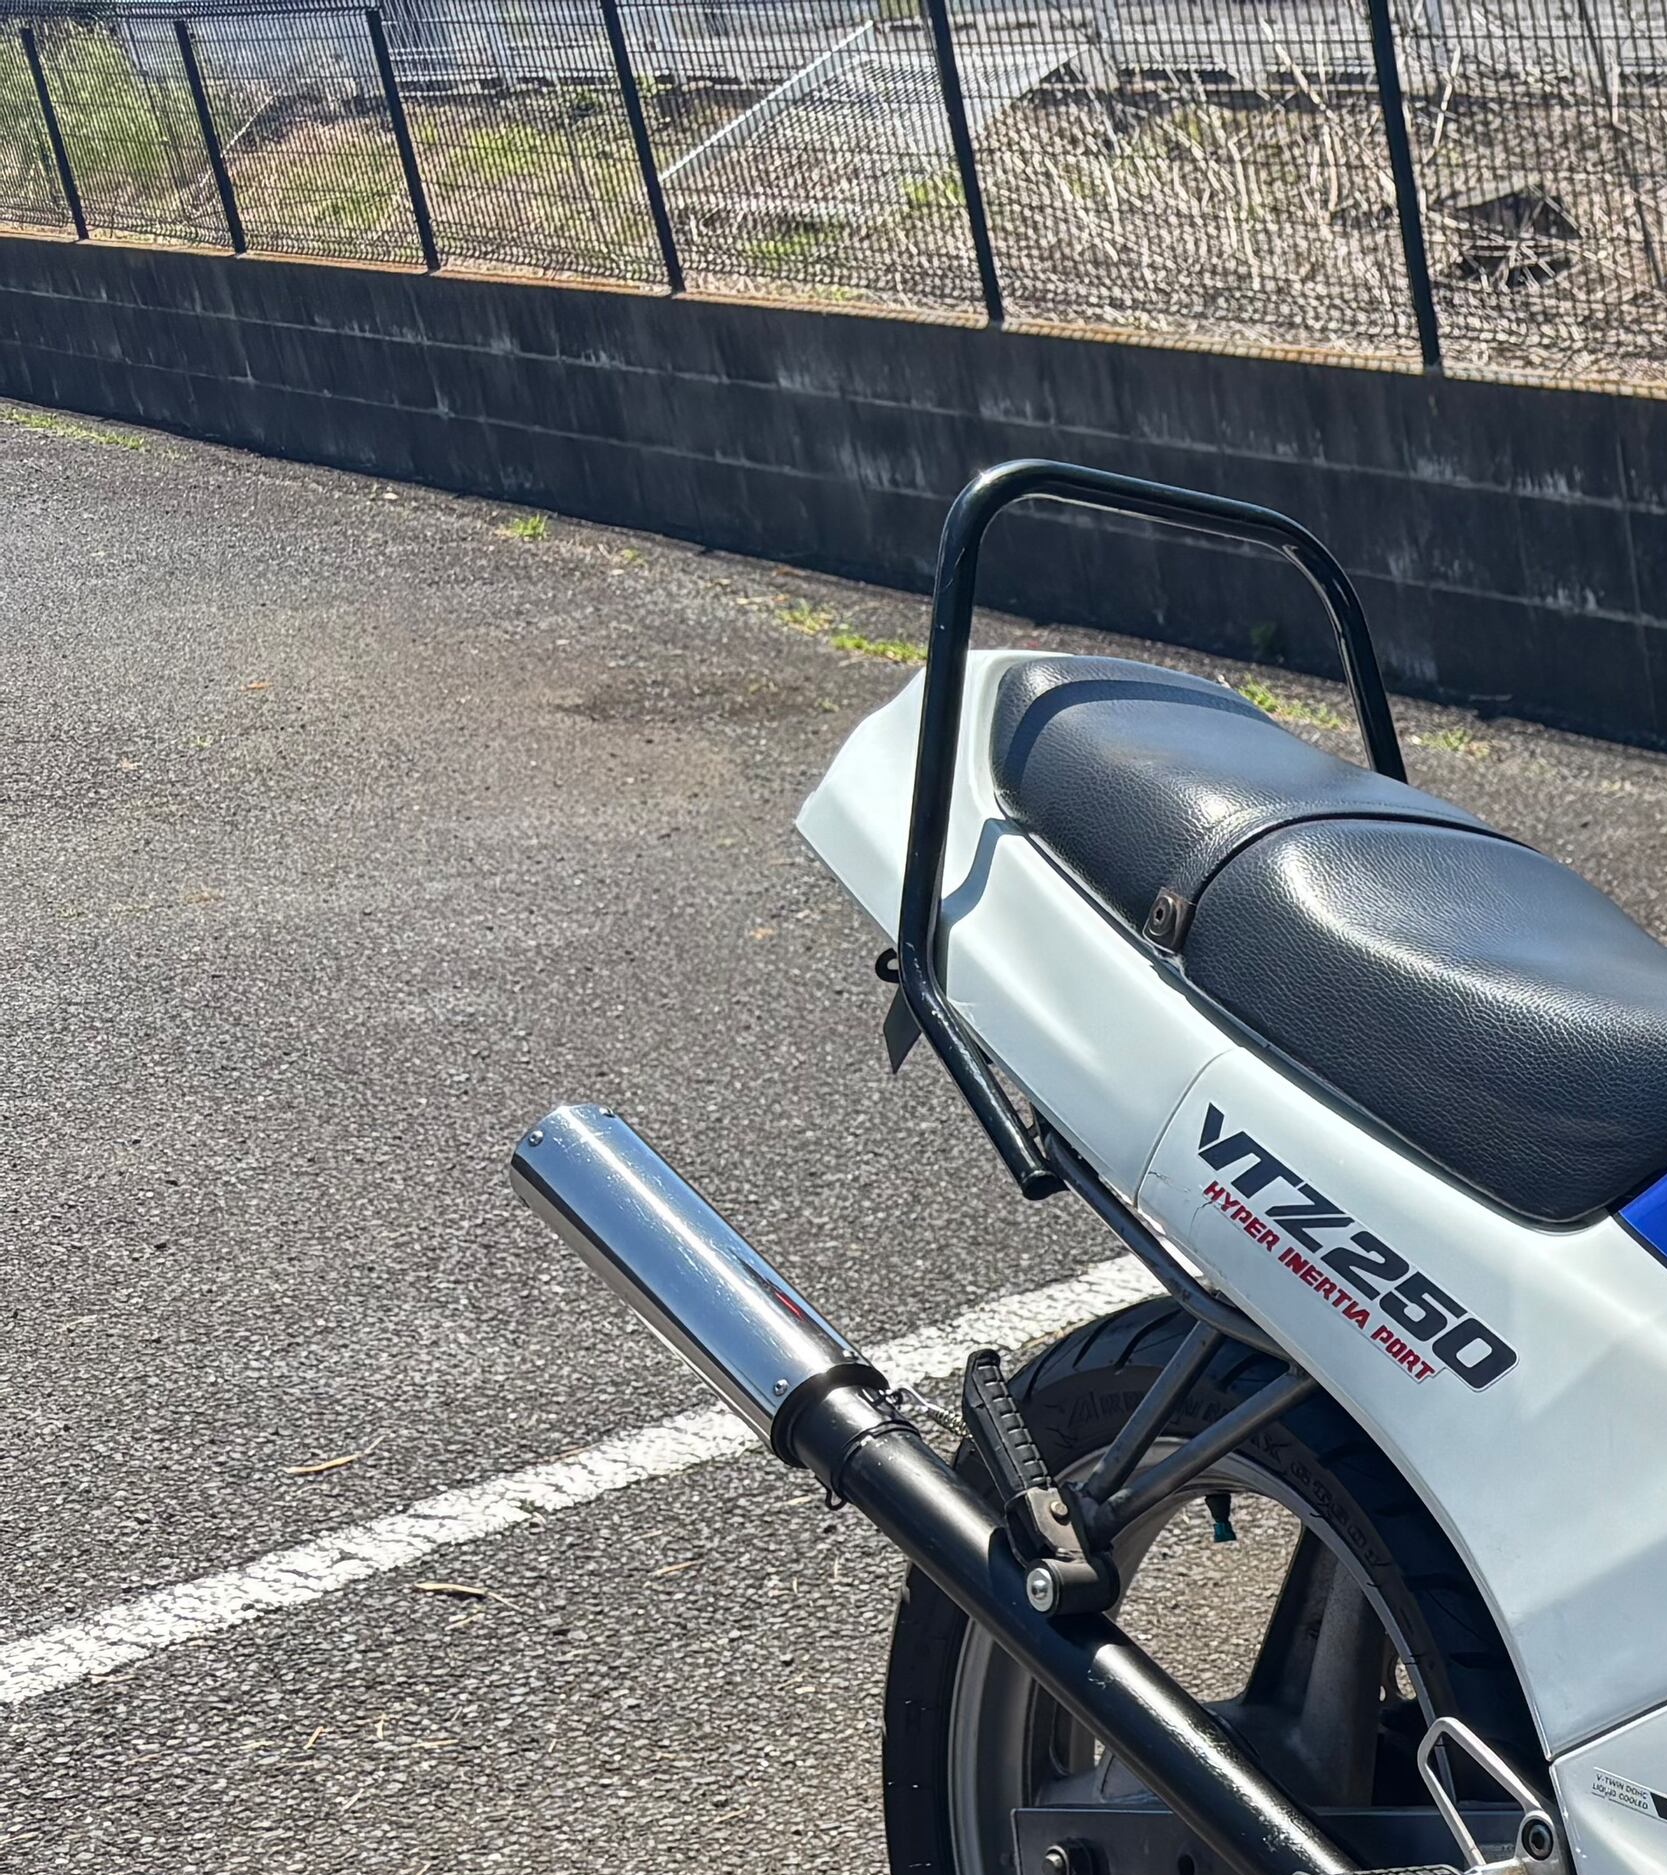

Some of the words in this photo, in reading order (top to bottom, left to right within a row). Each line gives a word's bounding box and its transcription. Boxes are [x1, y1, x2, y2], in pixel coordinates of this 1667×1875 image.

[1203, 1180, 1280, 1252] HYPER
[1277, 1246, 1371, 1330] INERTIA
[1370, 1324, 1436, 1381] PORT
[1625, 1785, 1648, 1800] DOHC
[1618, 1793, 1649, 1810] COOLED
